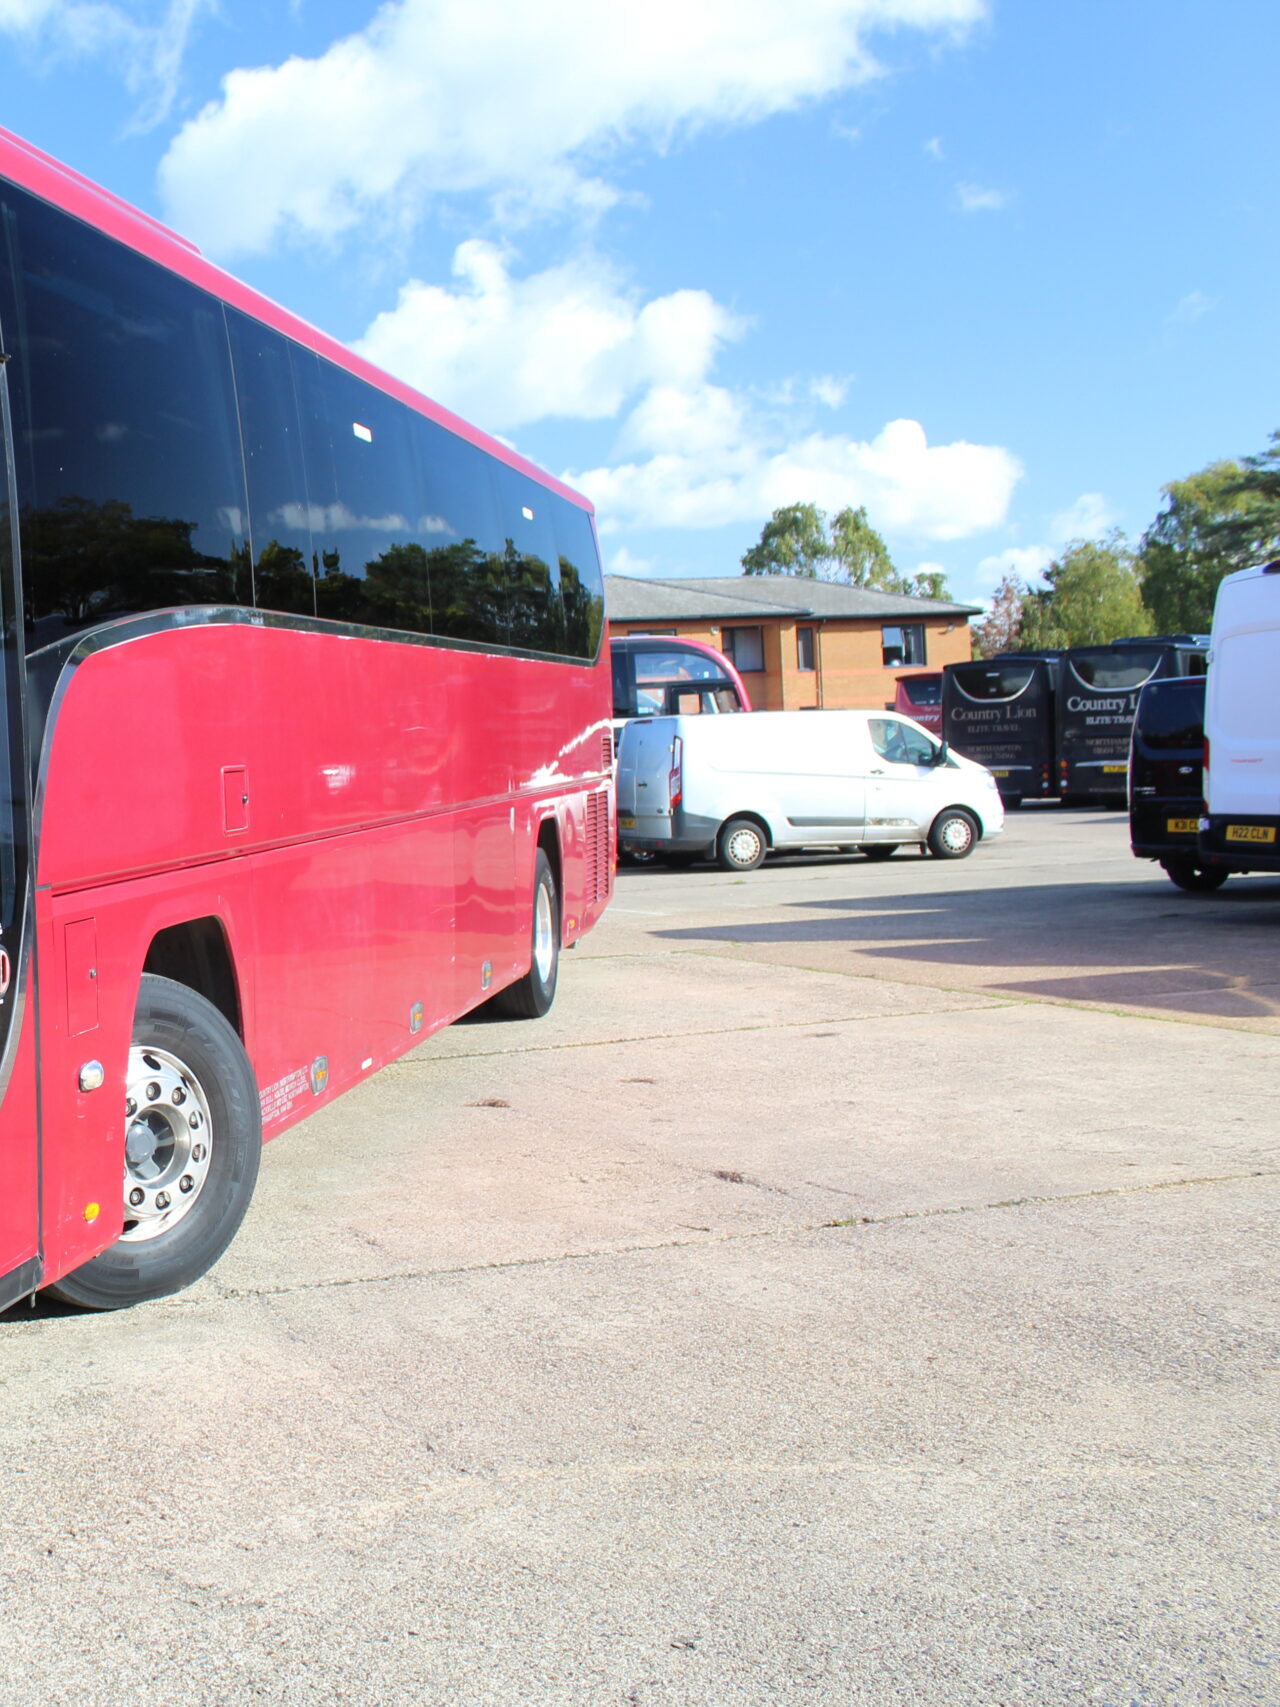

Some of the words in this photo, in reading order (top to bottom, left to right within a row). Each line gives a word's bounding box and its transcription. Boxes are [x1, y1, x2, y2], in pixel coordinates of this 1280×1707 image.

[1067, 695, 1126, 713] Country
[951, 706, 1002, 723] Country
[1006, 705, 1037, 719] Lion
[1232, 827, 1249, 839] H22
[1250, 828, 1268, 840] CLN
